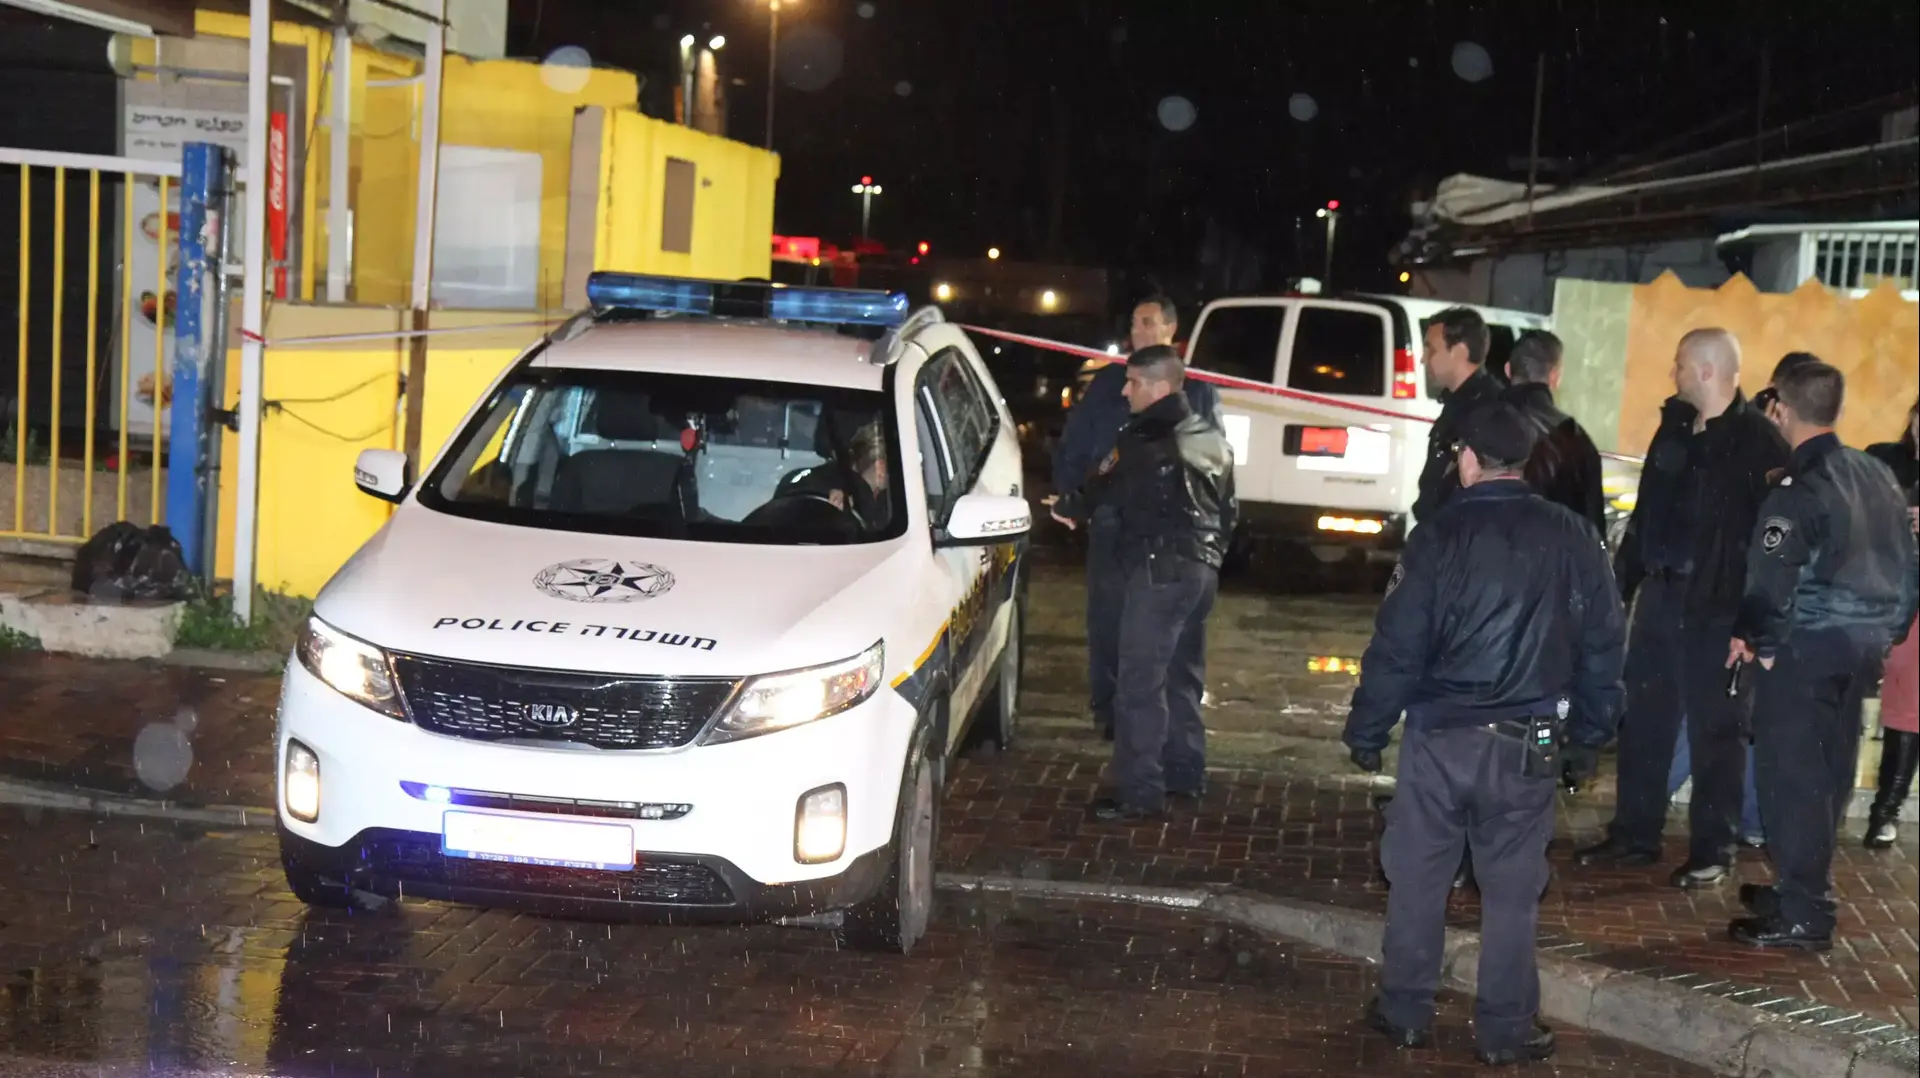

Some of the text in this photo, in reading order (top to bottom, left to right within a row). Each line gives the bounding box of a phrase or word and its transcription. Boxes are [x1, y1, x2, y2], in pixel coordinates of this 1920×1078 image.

[433, 617, 571, 634] POLICE
[580, 624, 718, 651] משטרה
[531, 703, 569, 723] KIA
